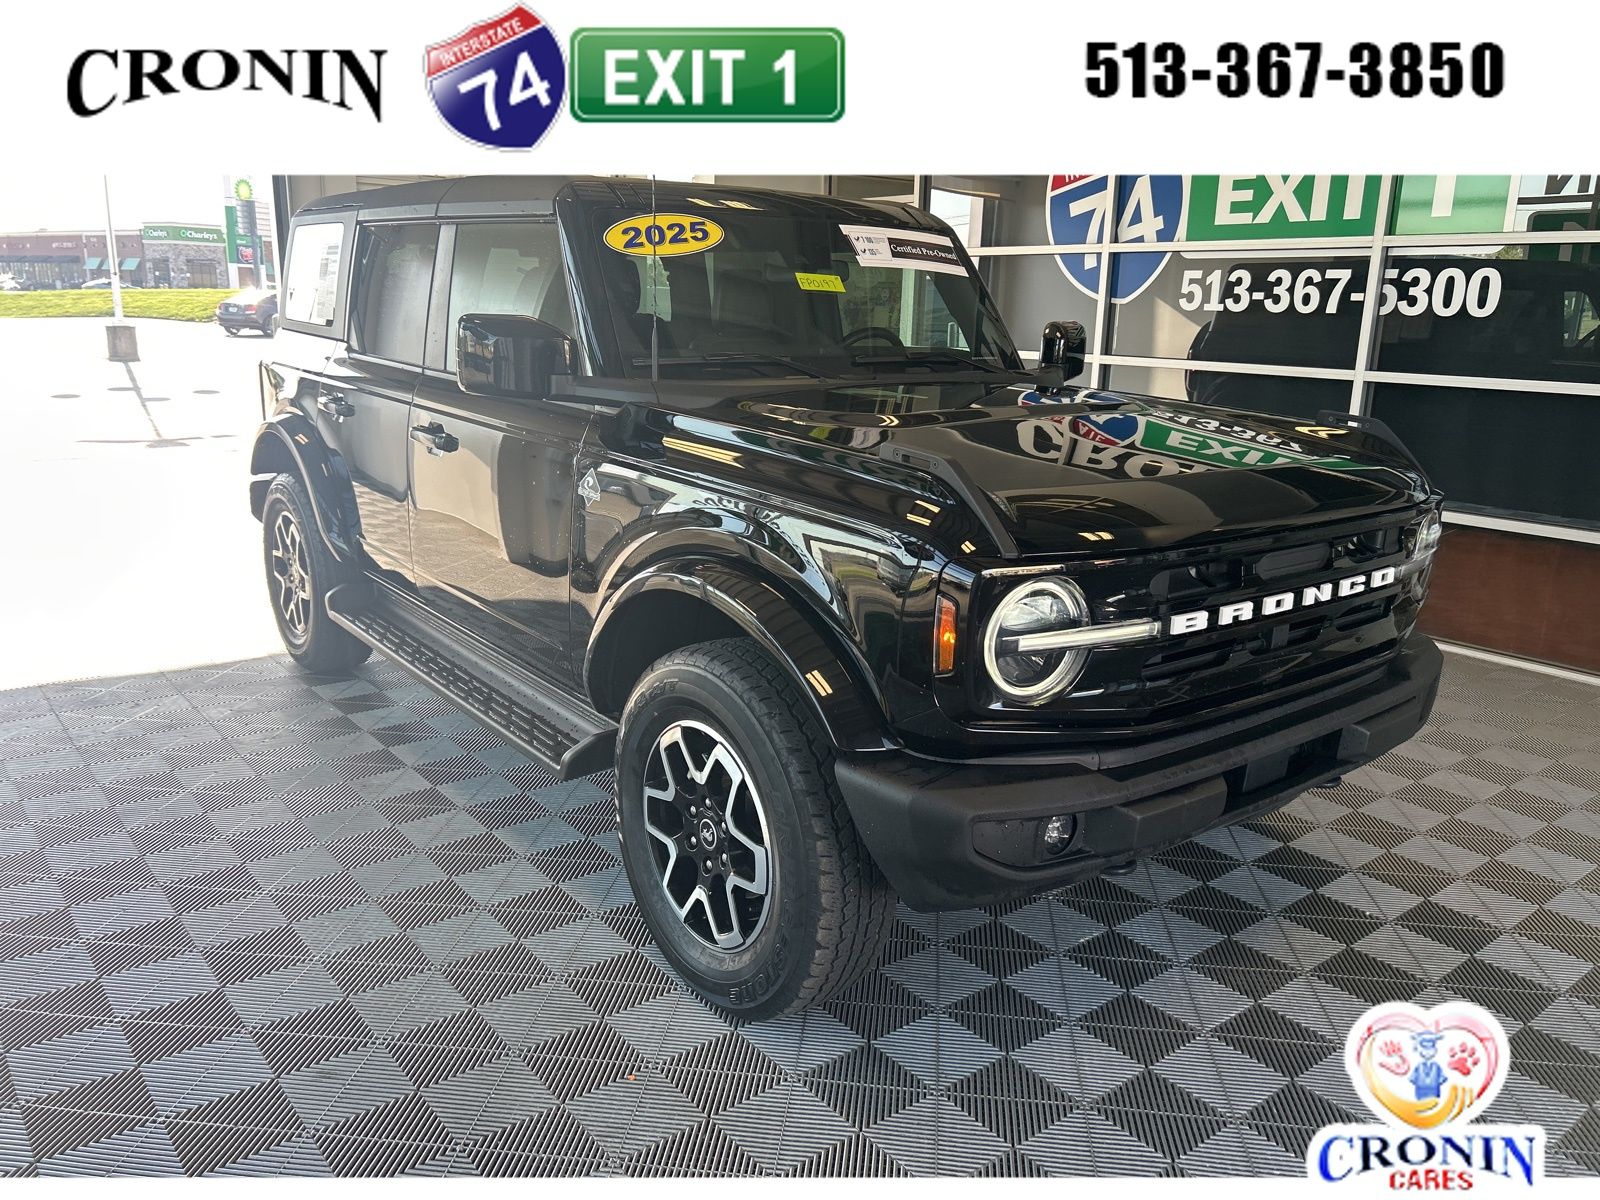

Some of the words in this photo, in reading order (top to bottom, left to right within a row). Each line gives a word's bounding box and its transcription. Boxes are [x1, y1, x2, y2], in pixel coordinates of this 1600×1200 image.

[622, 220, 710, 249] 2025
[1069, 175, 1164, 270] 74
[890, 244, 922, 255] Certified
[921, 247, 958, 260] Pre-Owned
[1179, 267, 1501, 317] 513-367-5300
[1169, 566, 1397, 637] BRONCO
